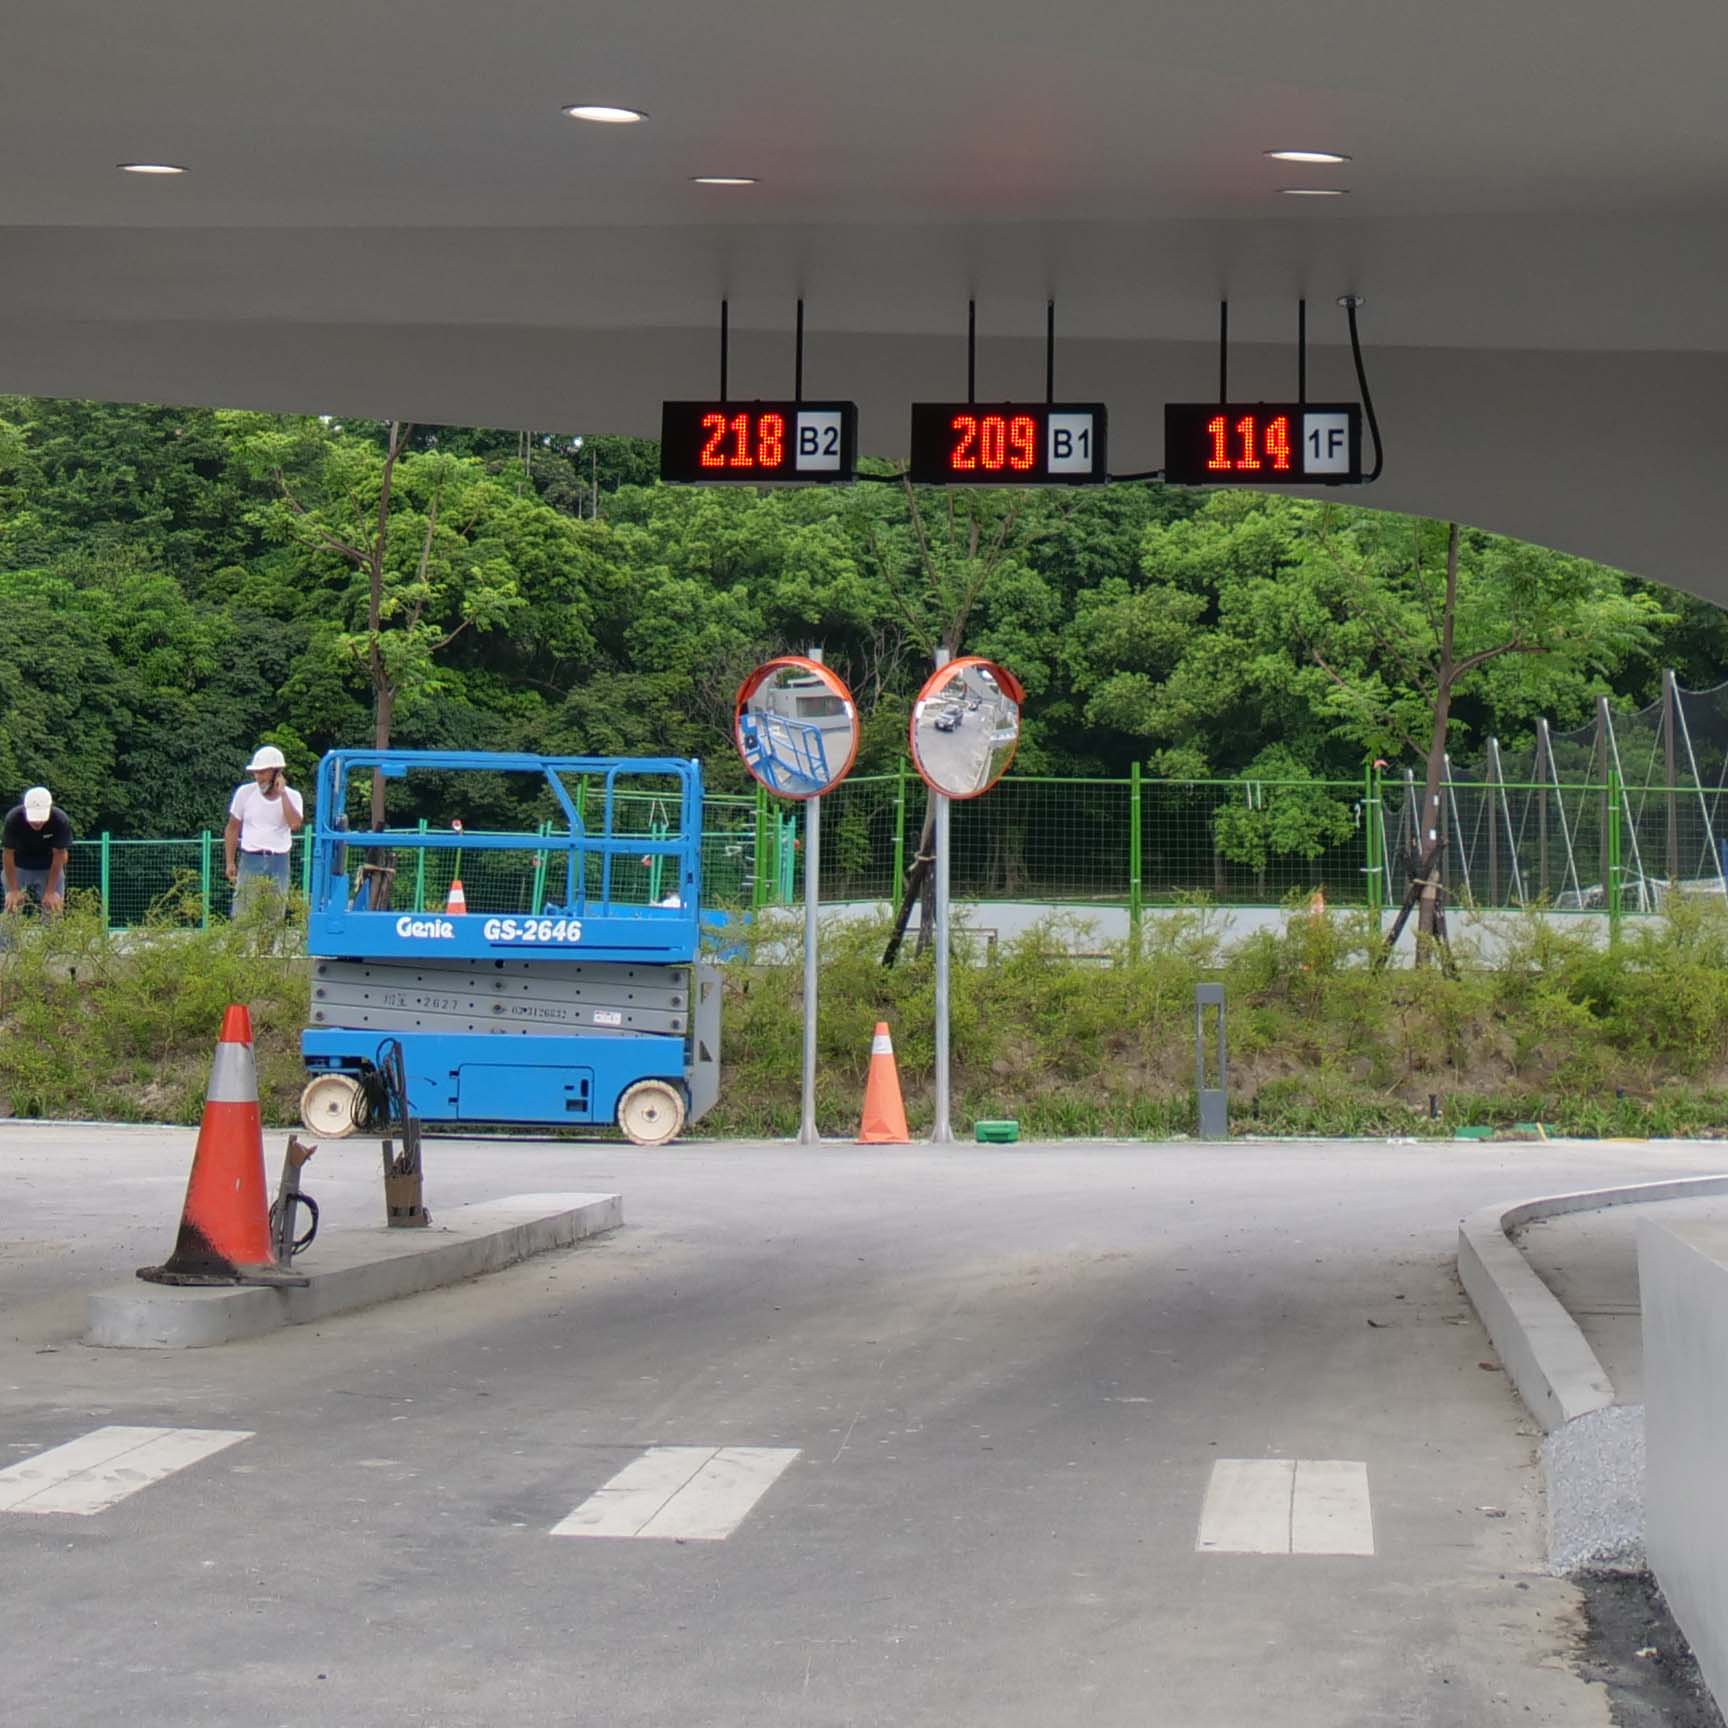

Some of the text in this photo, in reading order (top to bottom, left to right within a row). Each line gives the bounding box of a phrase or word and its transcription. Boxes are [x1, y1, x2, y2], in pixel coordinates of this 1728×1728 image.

[701, 414, 839, 466] 218 B2
[951, 416, 1089, 469] 209 B1
[1208, 416, 1345, 469] 114 1F
[396, 916, 582, 942] Genie GS-2646
